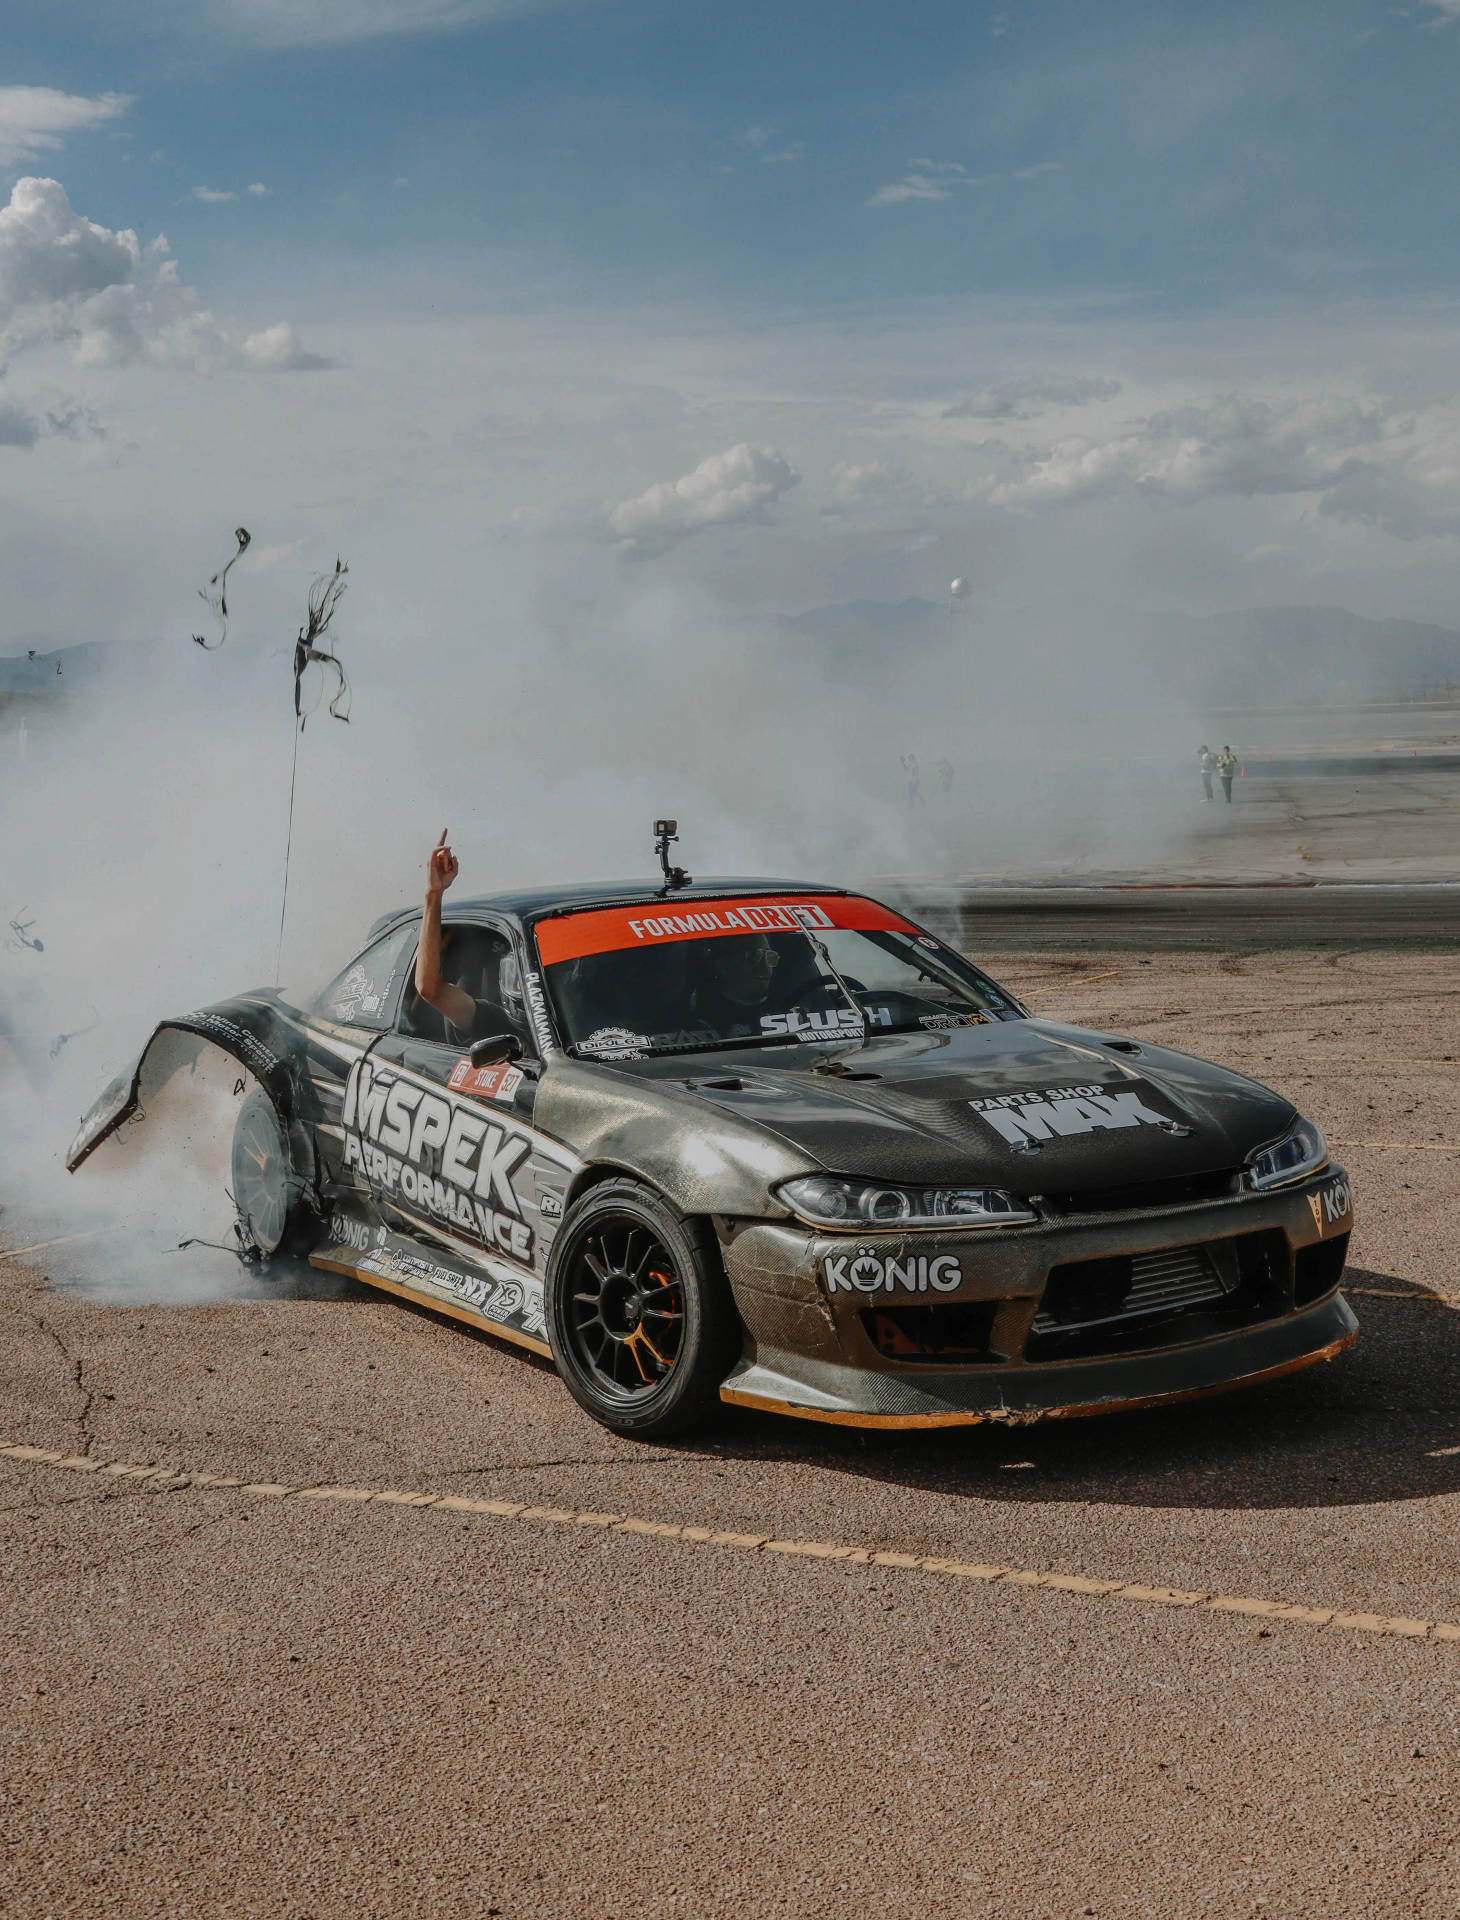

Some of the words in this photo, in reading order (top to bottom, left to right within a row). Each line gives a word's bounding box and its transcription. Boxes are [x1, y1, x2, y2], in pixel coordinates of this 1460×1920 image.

[628, 911, 746, 939] FORMULA
[743, 906, 828, 929] DRIFT
[210, 1014, 240, 1030] Wine
[240, 1029, 280, 1064] Country
[525, 972, 555, 1056] PLAZMAMAN
[759, 1007, 893, 1036] SLUSH
[206, 1018, 242, 1038] Motor
[243, 1038, 276, 1069] Sports
[967, 1092, 1043, 1112] PARTS
[1046, 1085, 1105, 1101] SHOP
[978, 1092, 1173, 1146] MAX
[341, 1058, 532, 1217] MSPEK
[343, 1131, 531, 1262] PERFORMANCE
[460, 1274, 493, 1303] NX
[824, 1248, 962, 1293] KÖNIG
